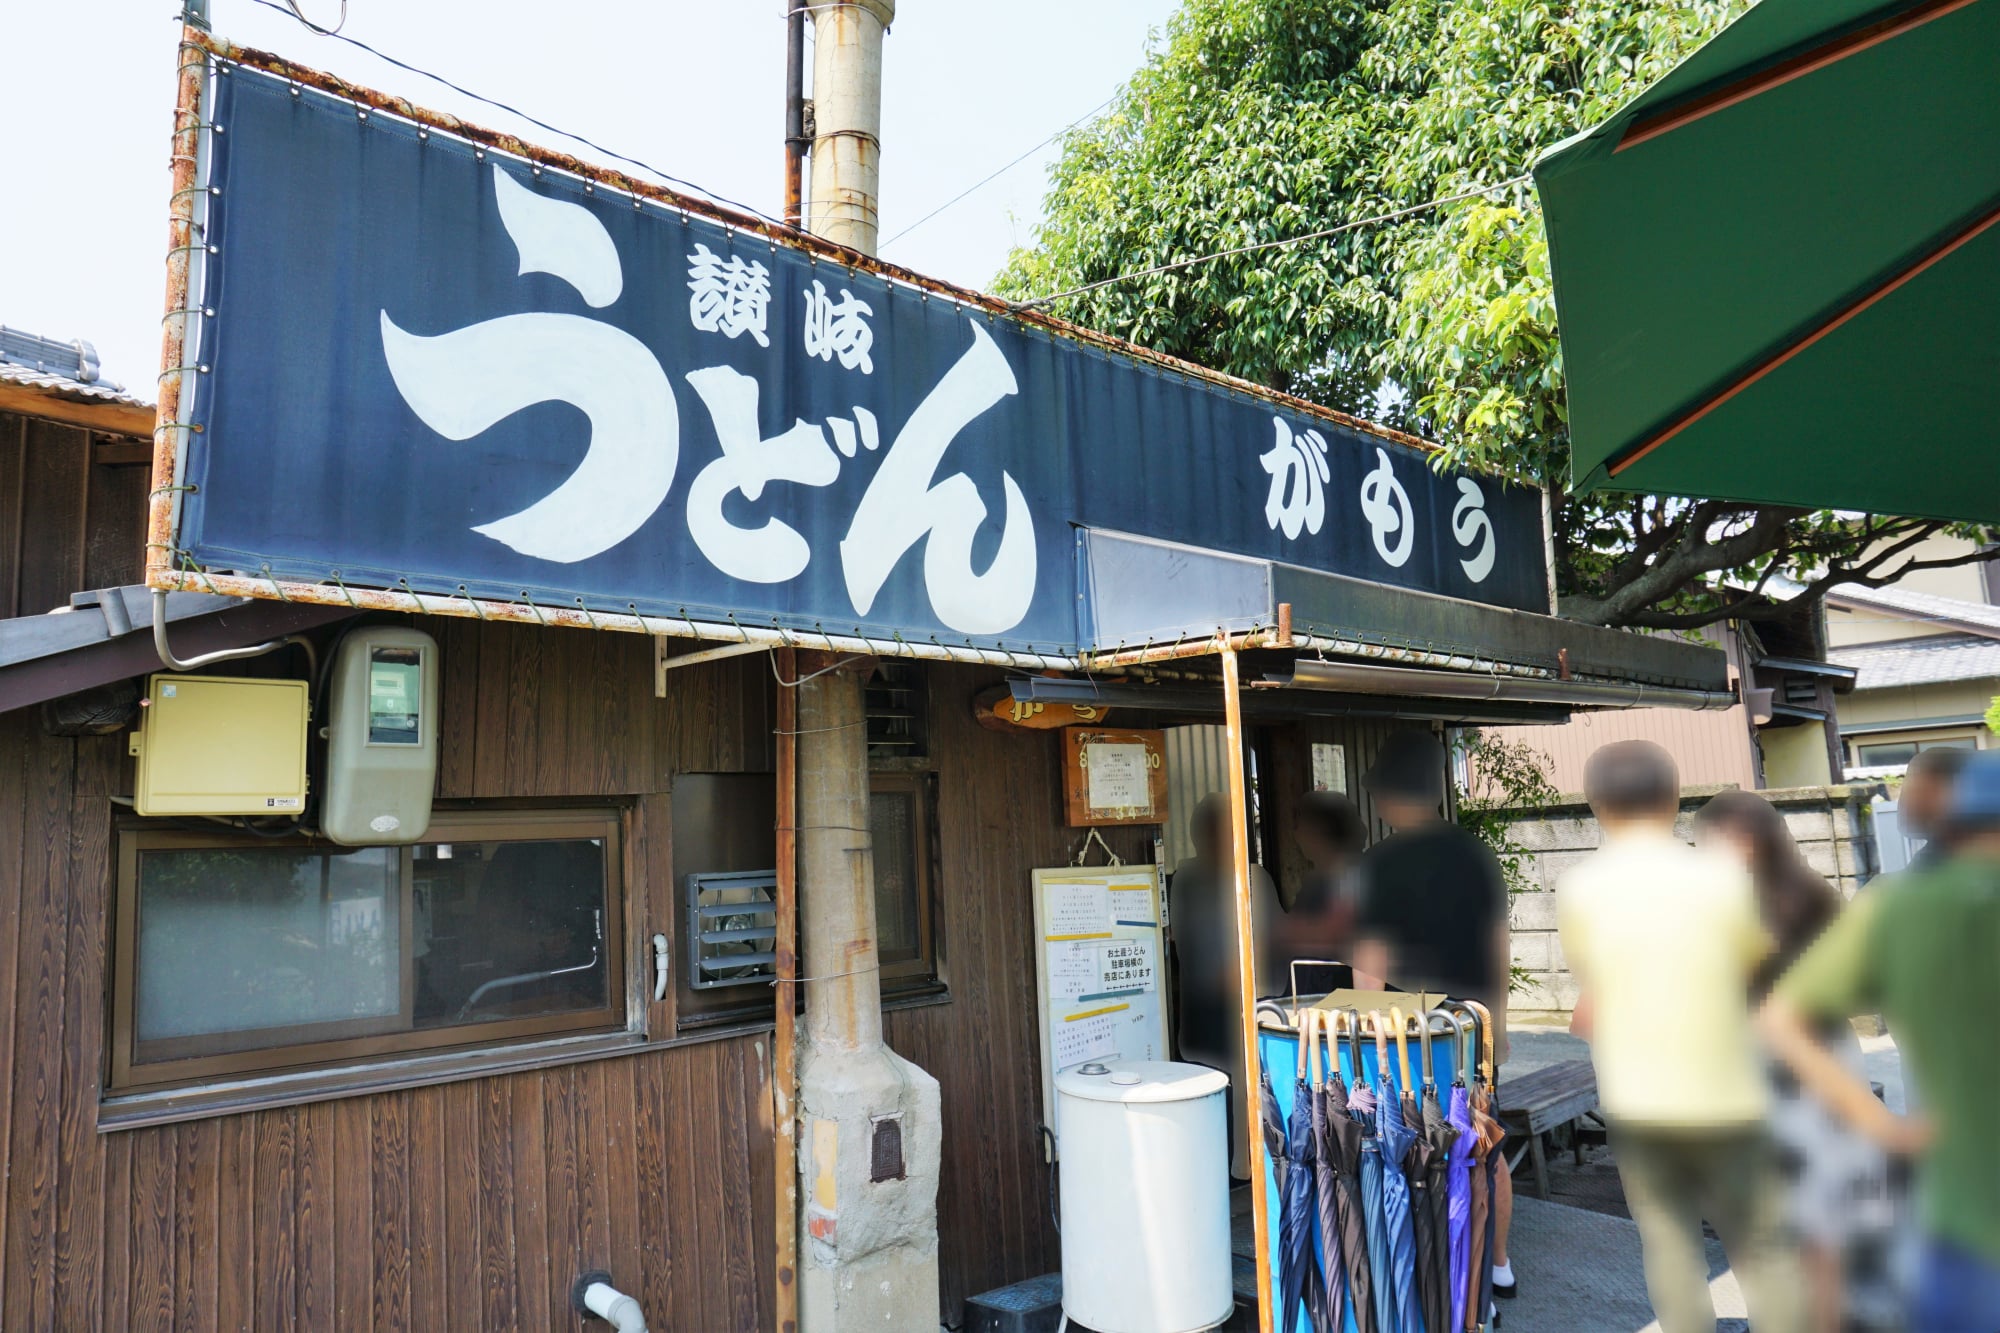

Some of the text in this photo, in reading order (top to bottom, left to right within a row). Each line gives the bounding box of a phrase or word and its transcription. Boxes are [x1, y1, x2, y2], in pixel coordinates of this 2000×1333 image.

[380, 162, 1038, 635] うどん
[1107, 946, 1146, 958] お土産うどん
[1104, 968, 1151, 982] 売店にあります
